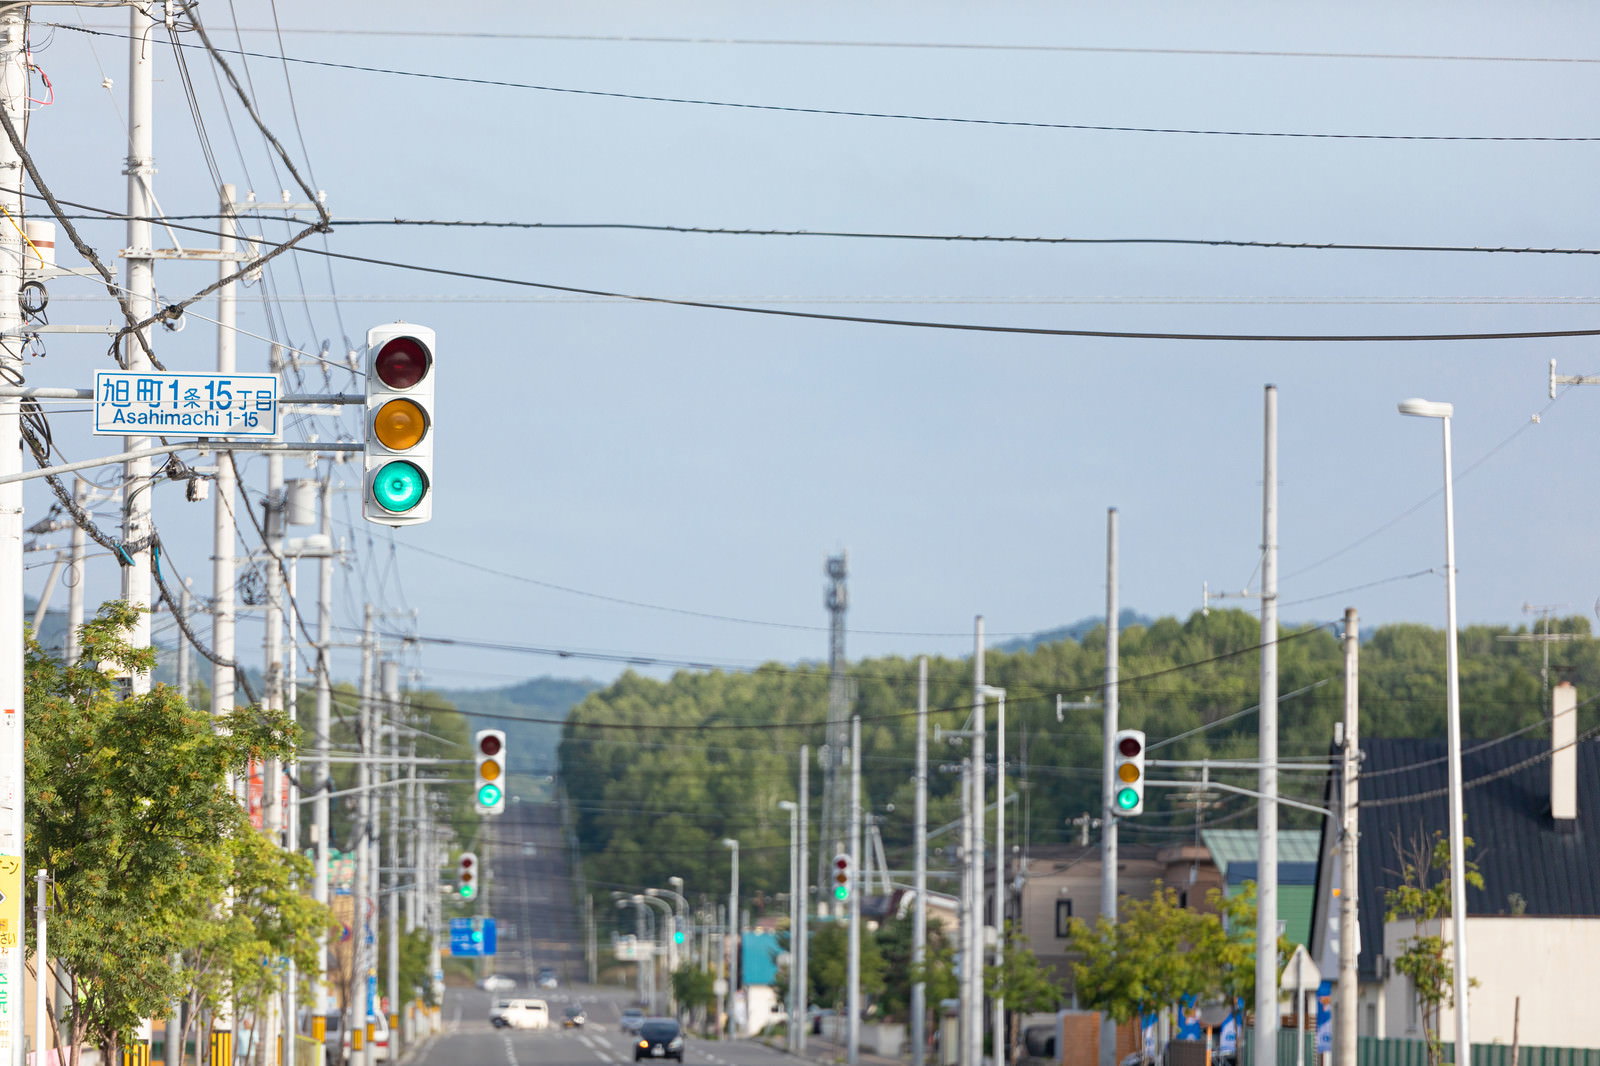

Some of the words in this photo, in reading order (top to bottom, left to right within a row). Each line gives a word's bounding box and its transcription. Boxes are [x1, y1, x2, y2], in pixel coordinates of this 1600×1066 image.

[101, 378, 272, 411] 旭町1条15丁目
[113, 408, 219, 427] Asahimachi
[226, 411, 259, 428] 1-15
